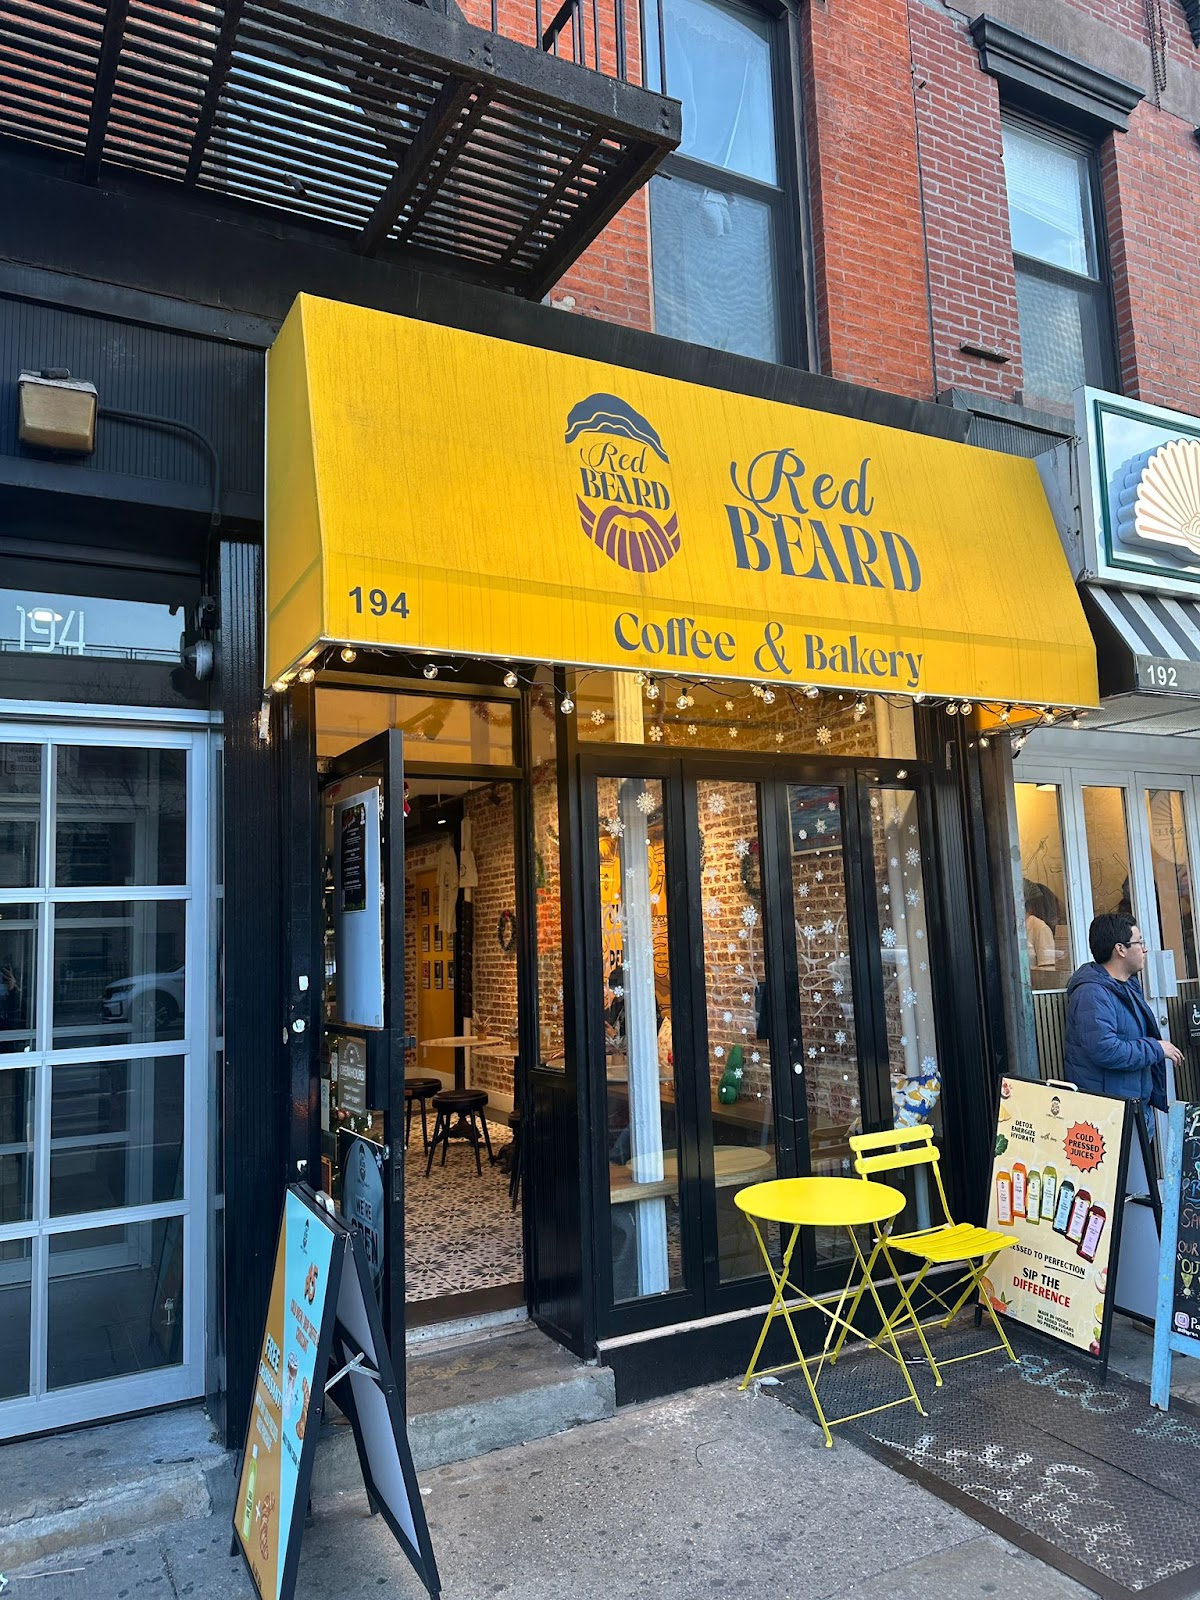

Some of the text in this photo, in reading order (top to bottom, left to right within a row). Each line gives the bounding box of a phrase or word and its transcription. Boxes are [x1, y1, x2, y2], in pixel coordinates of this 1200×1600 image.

[579, 441, 648, 474] Red
[578, 466, 671, 511] BEARD
[730, 447, 875, 521] Red
[723, 504, 922, 593] BEARD
[349, 586, 410, 619] 194
[16, 604, 86, 656] 194
[613, 611, 924, 688] Coffee & Bakery
[1147, 665, 1178, 687] 192
[1010, 1132, 1036, 1144] HYDRATE
[1011, 1126, 1036, 1137] ENERGIZE
[1015, 1120, 1034, 1130] DETOX
[1075, 1132, 1094, 1143] COLD
[1068, 1138, 1100, 1153] PRESSED
[1070, 1148, 1094, 1160] JUICES
[1009, 1244, 1086, 1276] ESSED TO PERFECTION
[1013, 1276, 1071, 1308] DIFFERENCE
[1022, 1267, 1060, 1290] SIP THE
[265, 1332, 280, 1374] FREE
